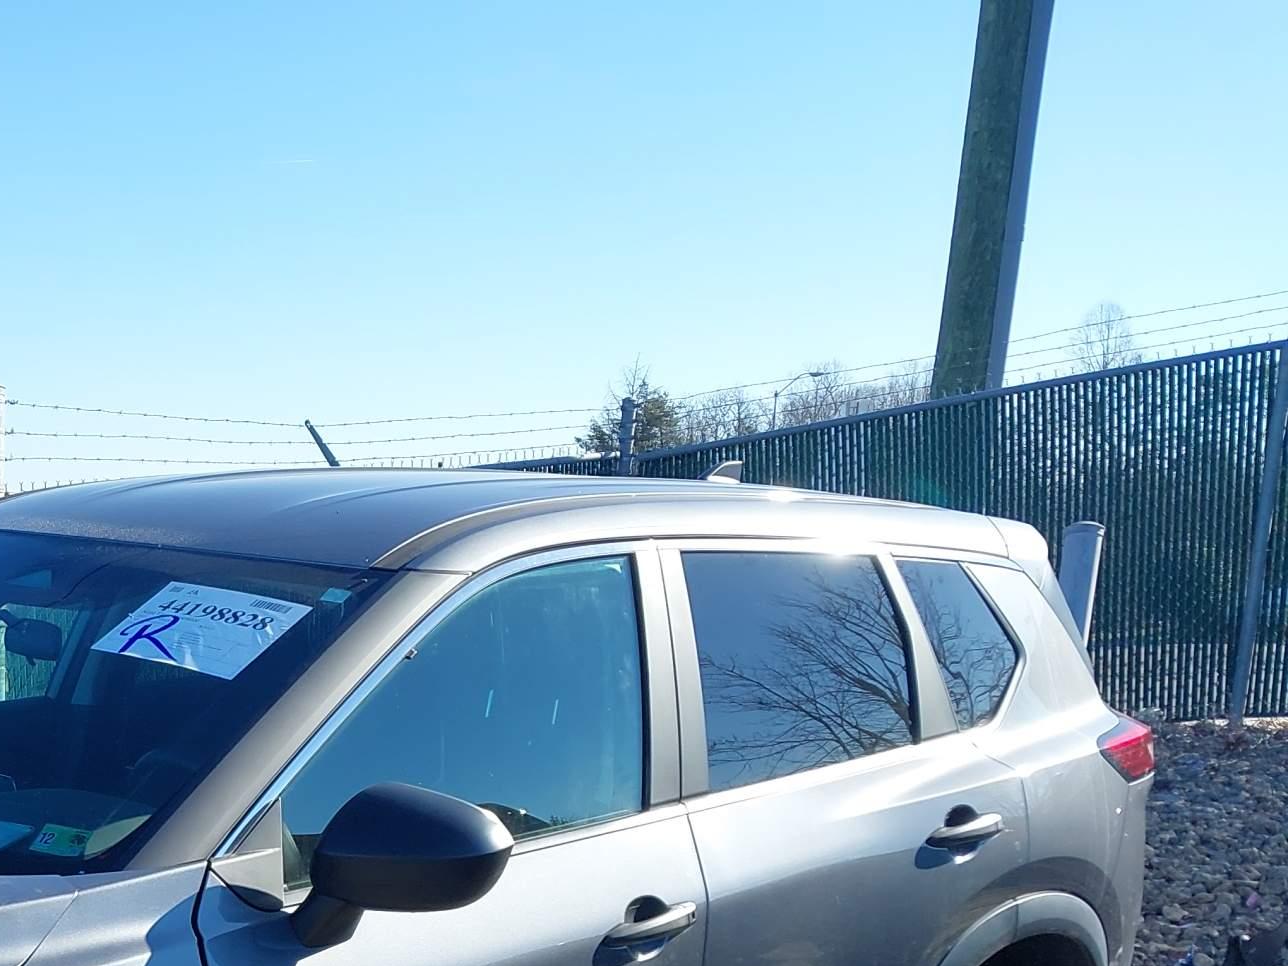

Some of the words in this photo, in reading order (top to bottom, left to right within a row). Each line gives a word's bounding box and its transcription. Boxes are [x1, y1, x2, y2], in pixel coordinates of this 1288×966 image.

[158, 599, 274, 631] 44198828
[119, 614, 180, 661] R
[39, 832, 56, 845] 12
